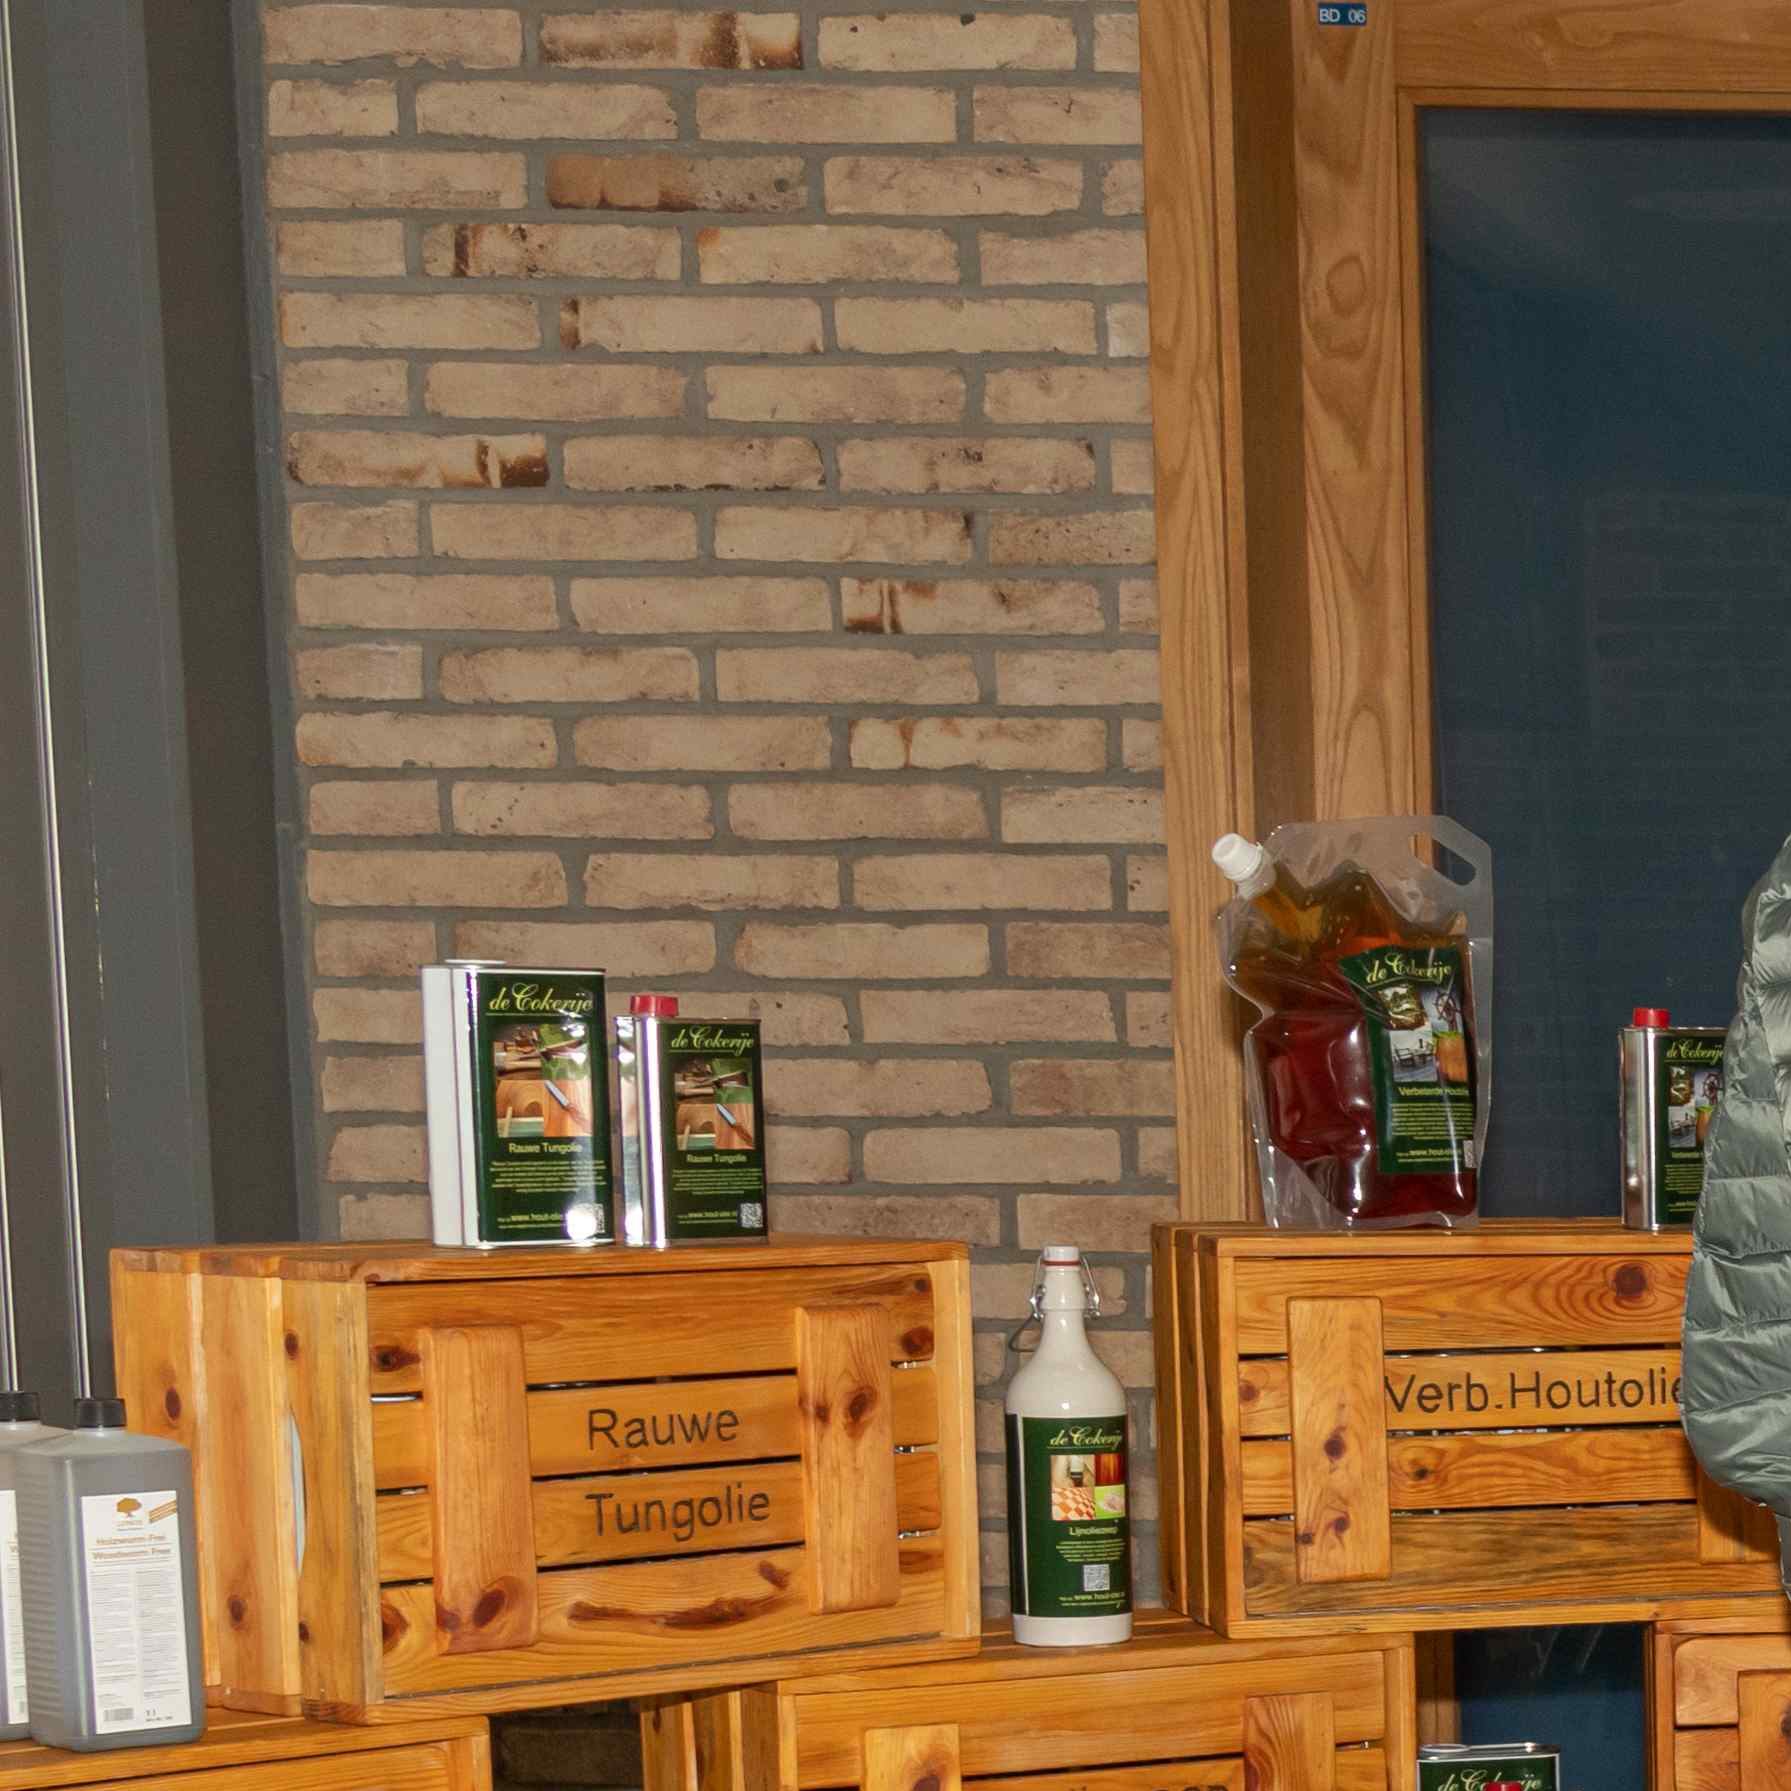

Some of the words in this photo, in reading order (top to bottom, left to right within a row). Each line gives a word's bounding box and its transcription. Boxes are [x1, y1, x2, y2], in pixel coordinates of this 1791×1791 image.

[1319, 8, 1340, 23] BD
[489, 986, 510, 1010] de
[671, 1029, 689, 1048] de
[508, 1143, 540, 1154] Rauwe
[586, 1407, 741, 1451] Rauwe
[587, 1486, 770, 1543] Tungolie
